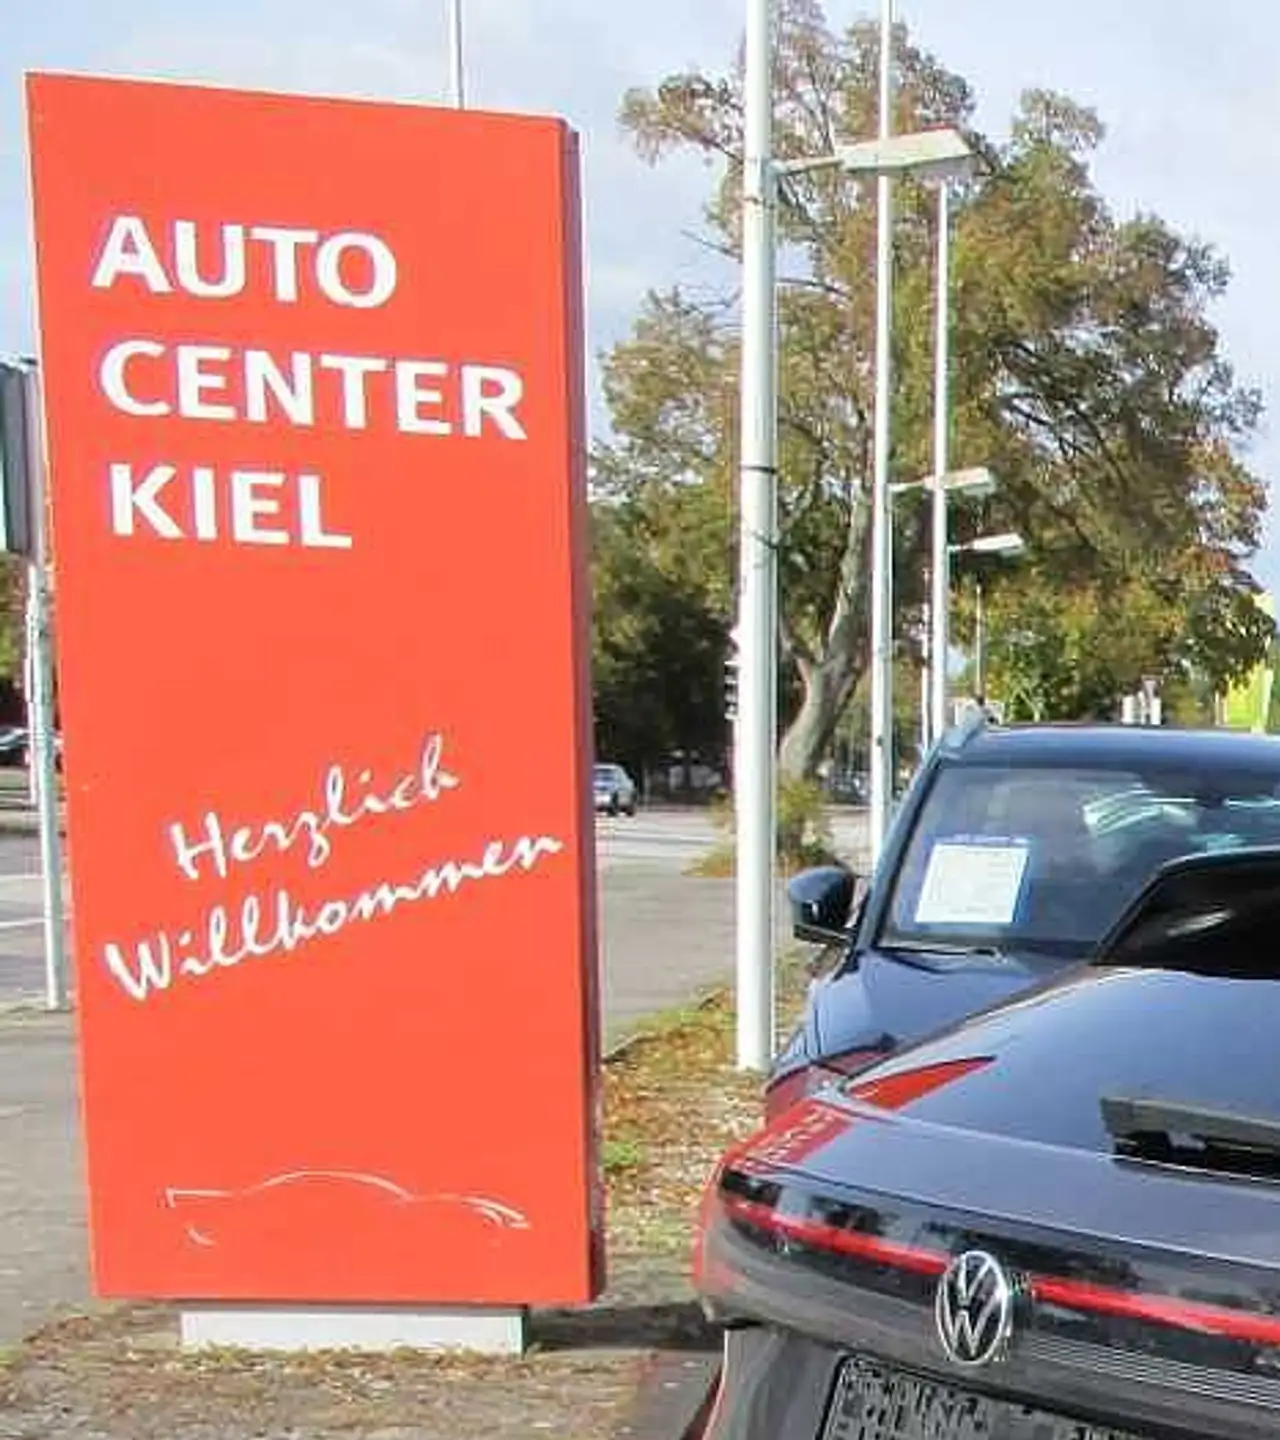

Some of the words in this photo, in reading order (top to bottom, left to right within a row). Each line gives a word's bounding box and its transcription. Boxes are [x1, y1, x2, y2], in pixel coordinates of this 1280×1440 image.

[92, 215, 397, 310] AUTO
[99, 340, 528, 441] CENTER
[108, 463, 353, 549] KIEL
[171, 733, 462, 882] Herzlich
[103, 832, 568, 1001] Willkommen
